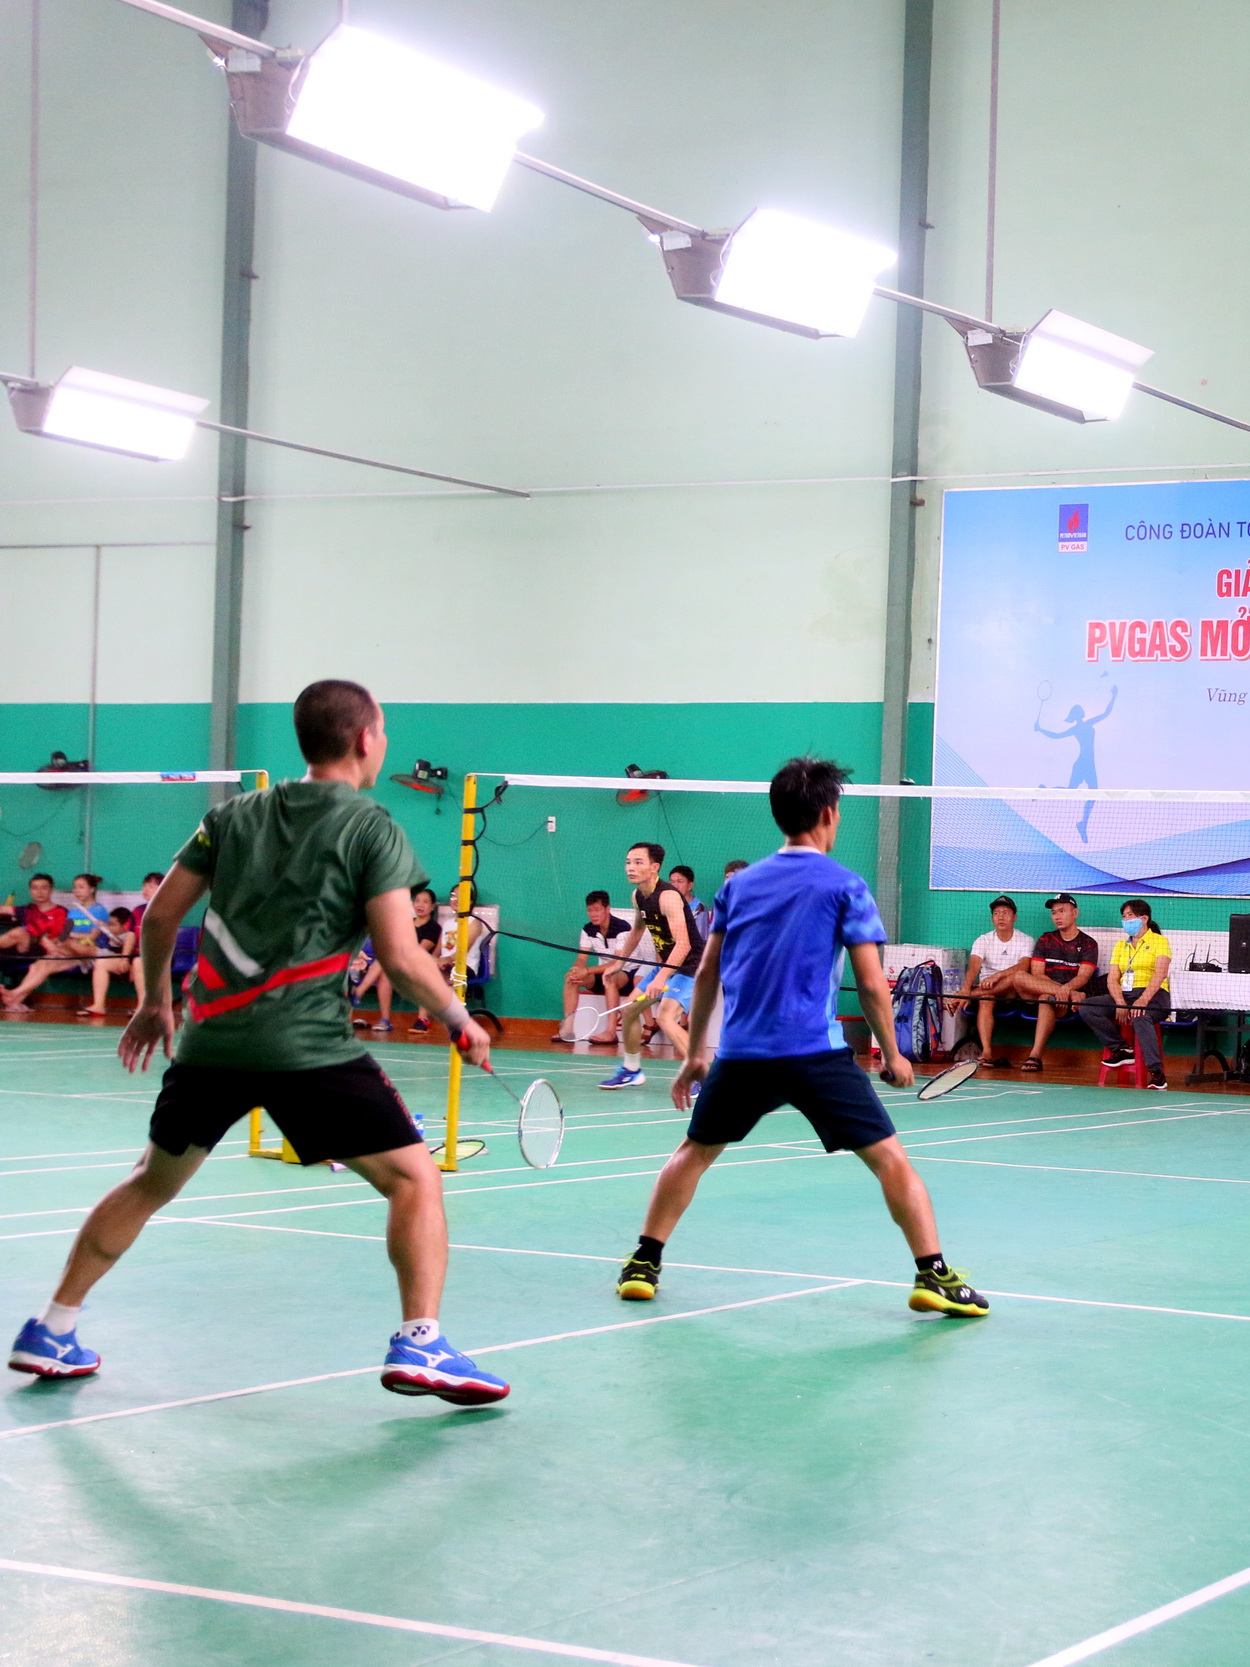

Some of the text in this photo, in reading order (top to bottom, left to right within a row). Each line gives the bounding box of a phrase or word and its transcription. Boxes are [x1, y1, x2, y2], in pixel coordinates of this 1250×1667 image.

[1124, 520, 1173, 541] CÔNG
[1179, 518, 1231, 540] ĐOÀN
[1071, 543, 1085, 551] GAS
[1085, 618, 1192, 663] PVGAS
[1206, 687, 1248, 706] Vũng
